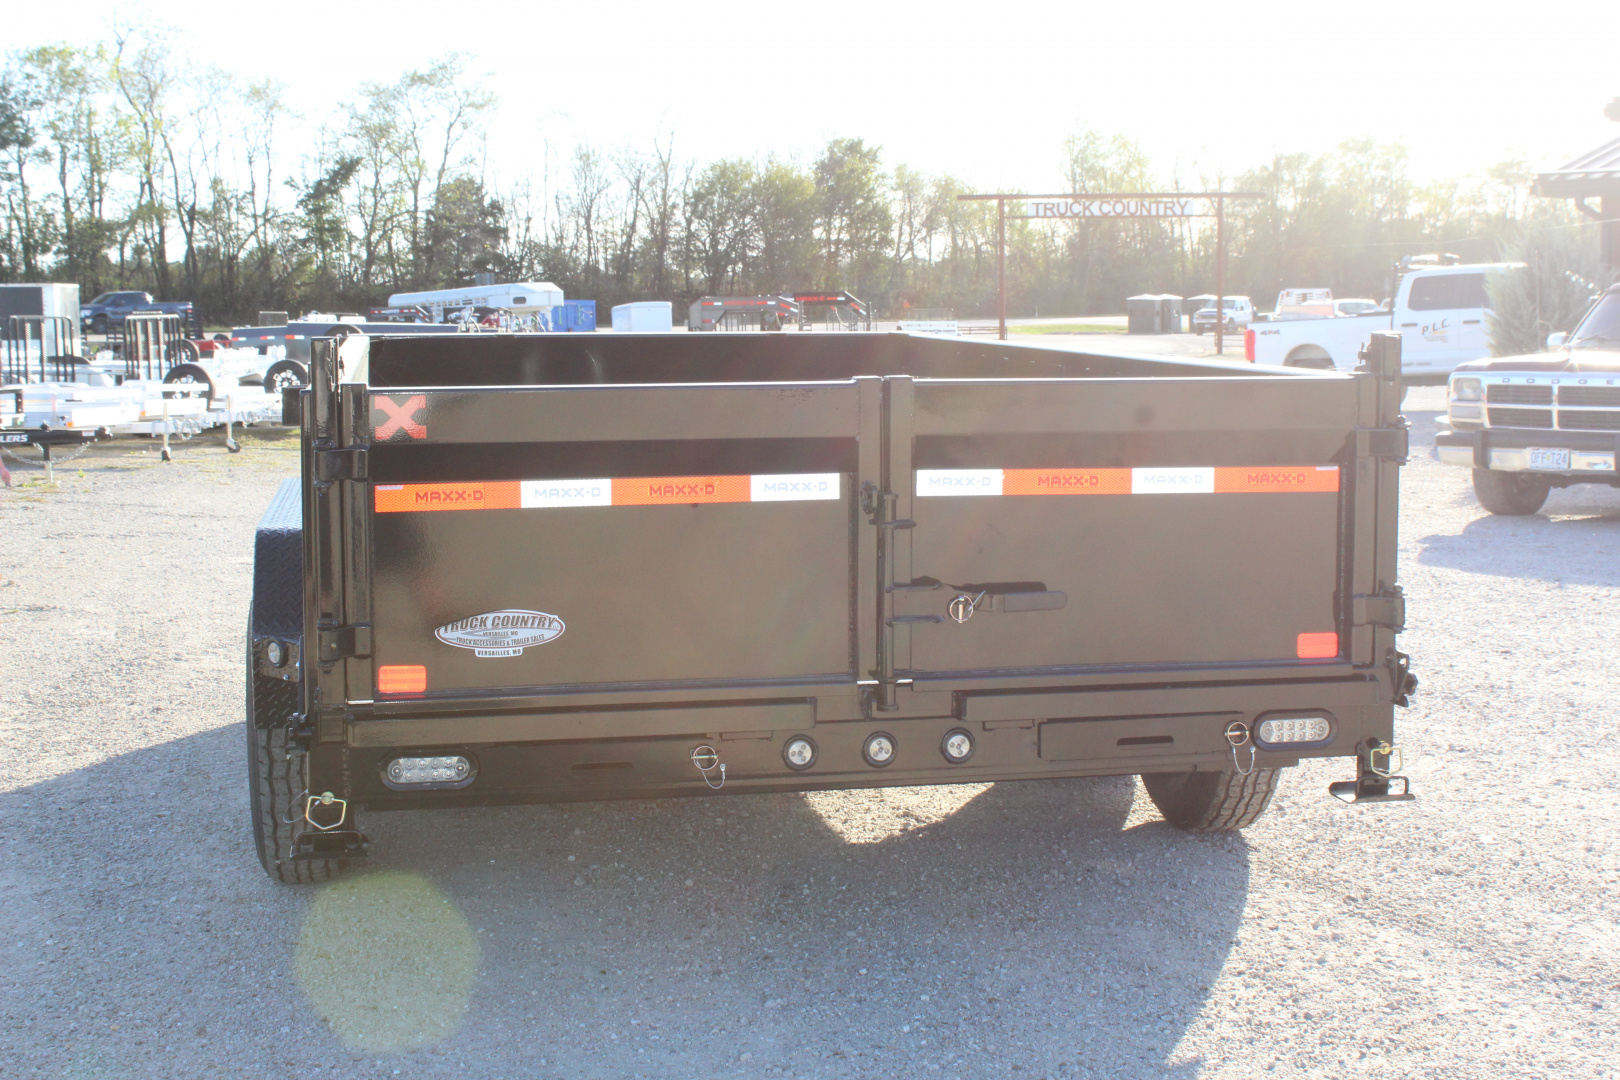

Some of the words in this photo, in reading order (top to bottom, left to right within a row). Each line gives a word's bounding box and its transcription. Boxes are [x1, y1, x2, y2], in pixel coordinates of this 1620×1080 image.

[1032, 201, 1095, 217] TRUCK
[1099, 200, 1189, 216] COUNTRY
[1502, 377, 1616, 385] DODGE
[374, 395, 427, 440] X
[443, 616, 490, 634] TRUCK
[491, 614, 557, 629] COUNTRY
[456, 637, 472, 645] TRUCK
[472, 638, 506, 647] ACCESSORIES
[511, 638, 531, 646] TRAILER
[531, 634, 545, 642] SALES
